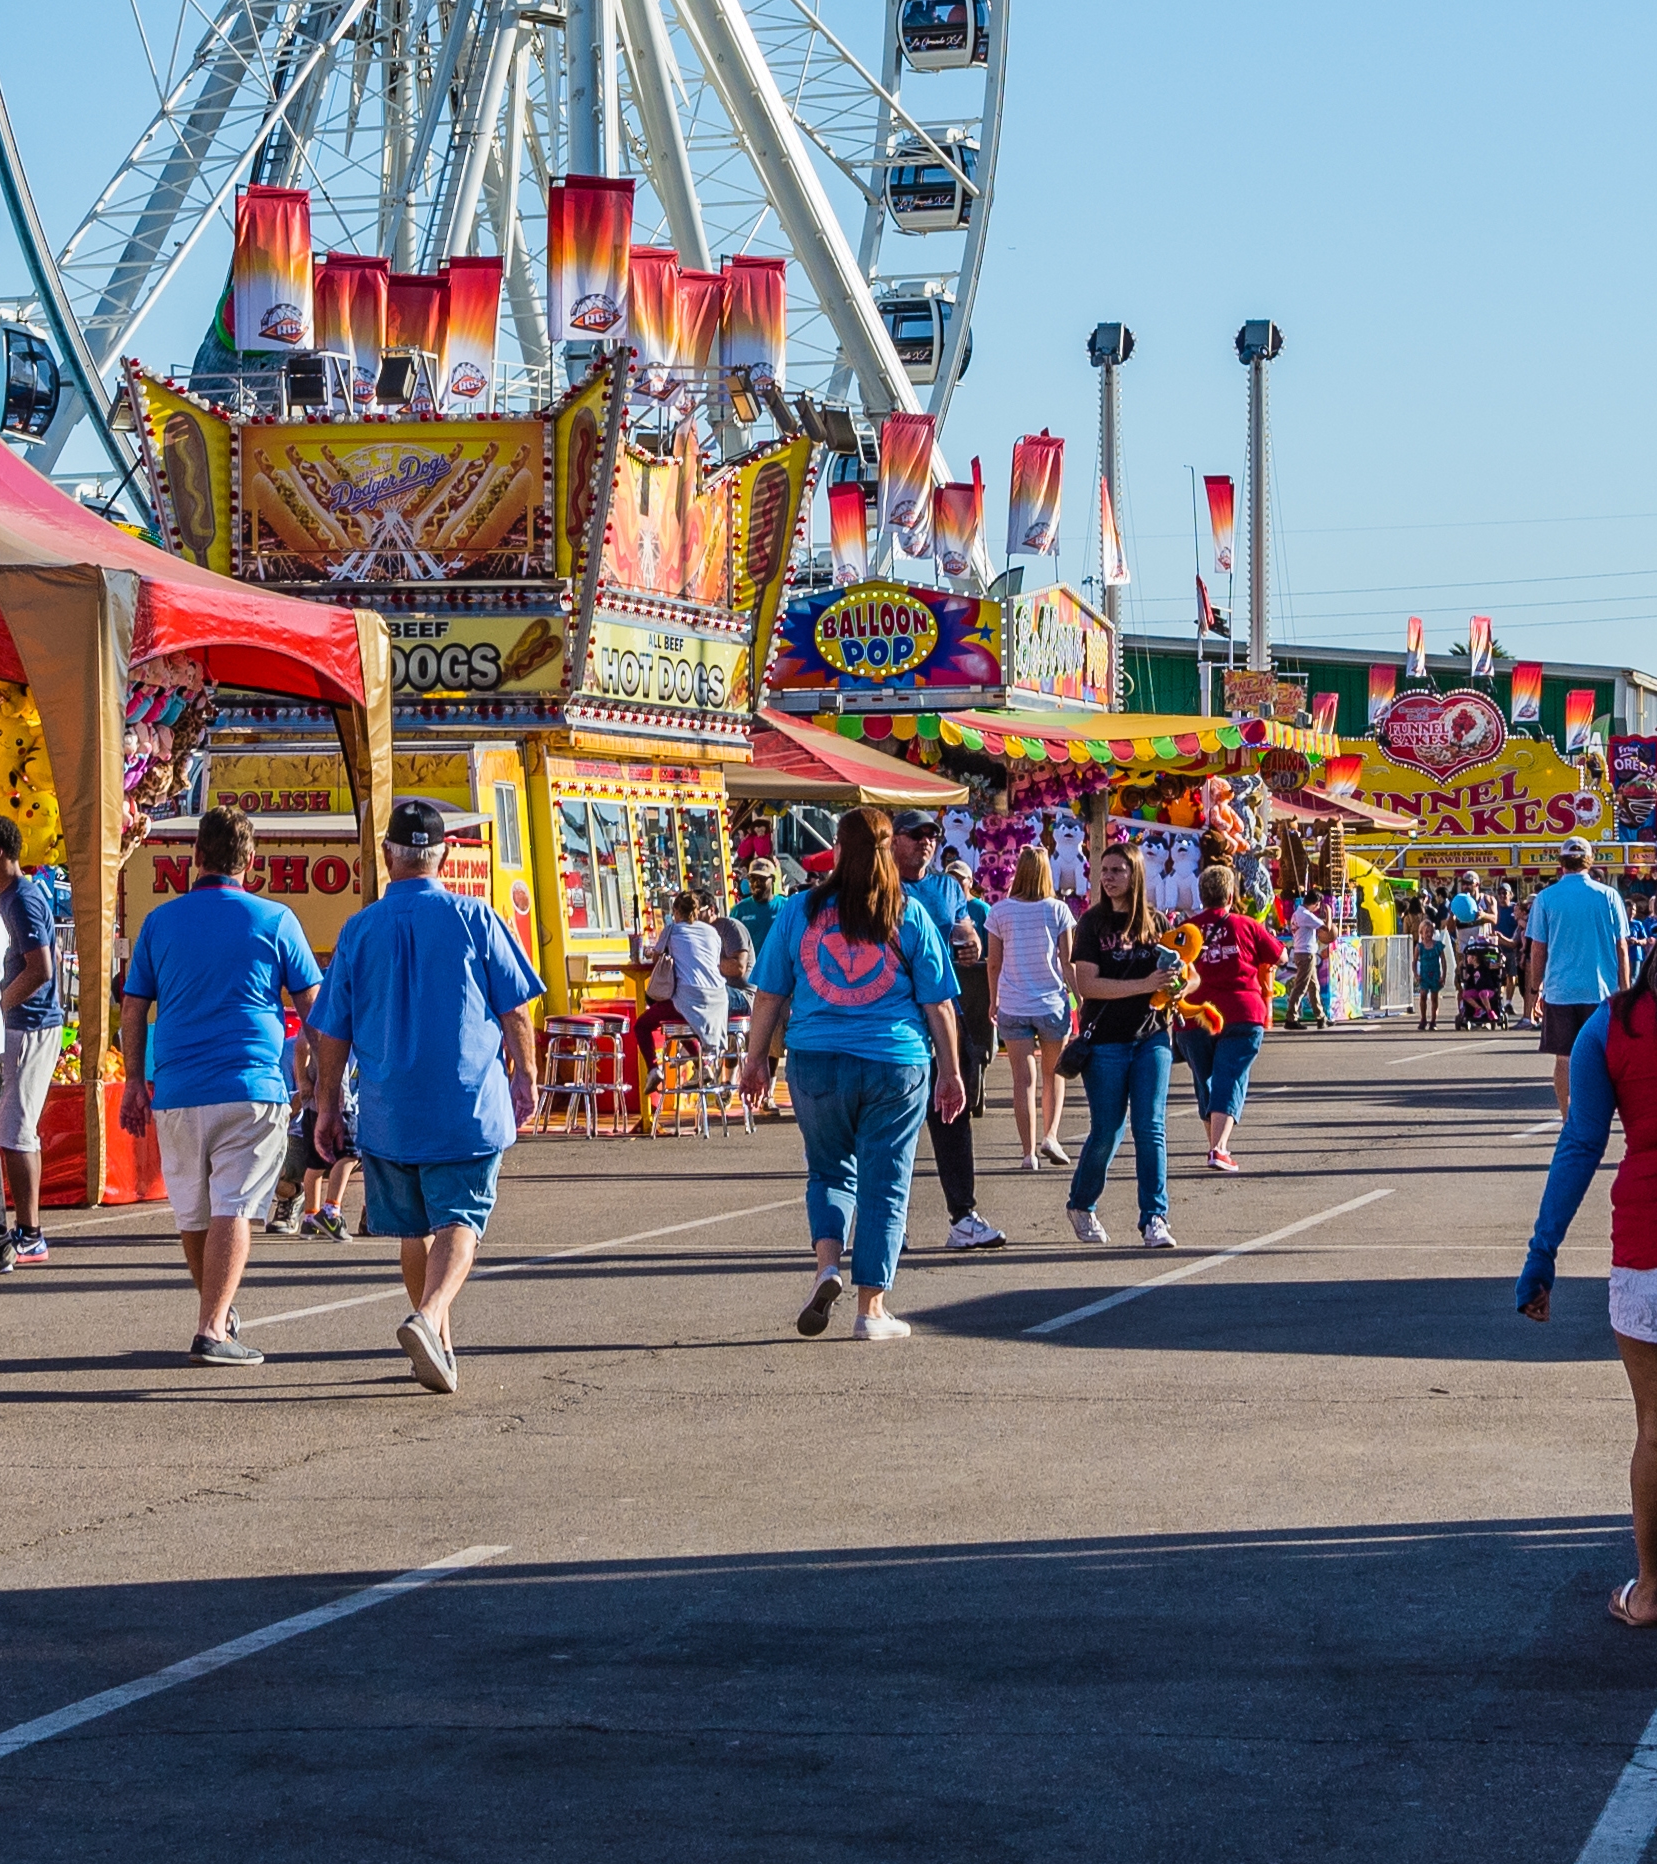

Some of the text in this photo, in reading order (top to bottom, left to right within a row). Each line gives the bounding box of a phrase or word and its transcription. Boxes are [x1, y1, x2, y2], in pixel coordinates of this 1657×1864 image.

[583, 312, 614, 326] RCS
[459, 379, 481, 390] RCS
[329, 454, 452, 511] Dodger Dogs
[388, 621, 450, 638] BEEF
[822, 602, 928, 639] BALLOON
[648, 633, 685, 652] ALL BEEF
[841, 635, 916, 668] POP
[601, 646, 725, 708] HOT DOGS
[1389, 722, 1449, 735] FUNNEL
[1391, 734, 1449, 747] CAKES
[217, 790, 331, 812] POLISH
[1396, 792, 1578, 837] AKES
[1418, 856, 1500, 865] STRAWBERRIES
[1530, 853, 1614, 862] LEMDE
[152, 855, 361, 894] NCHO
